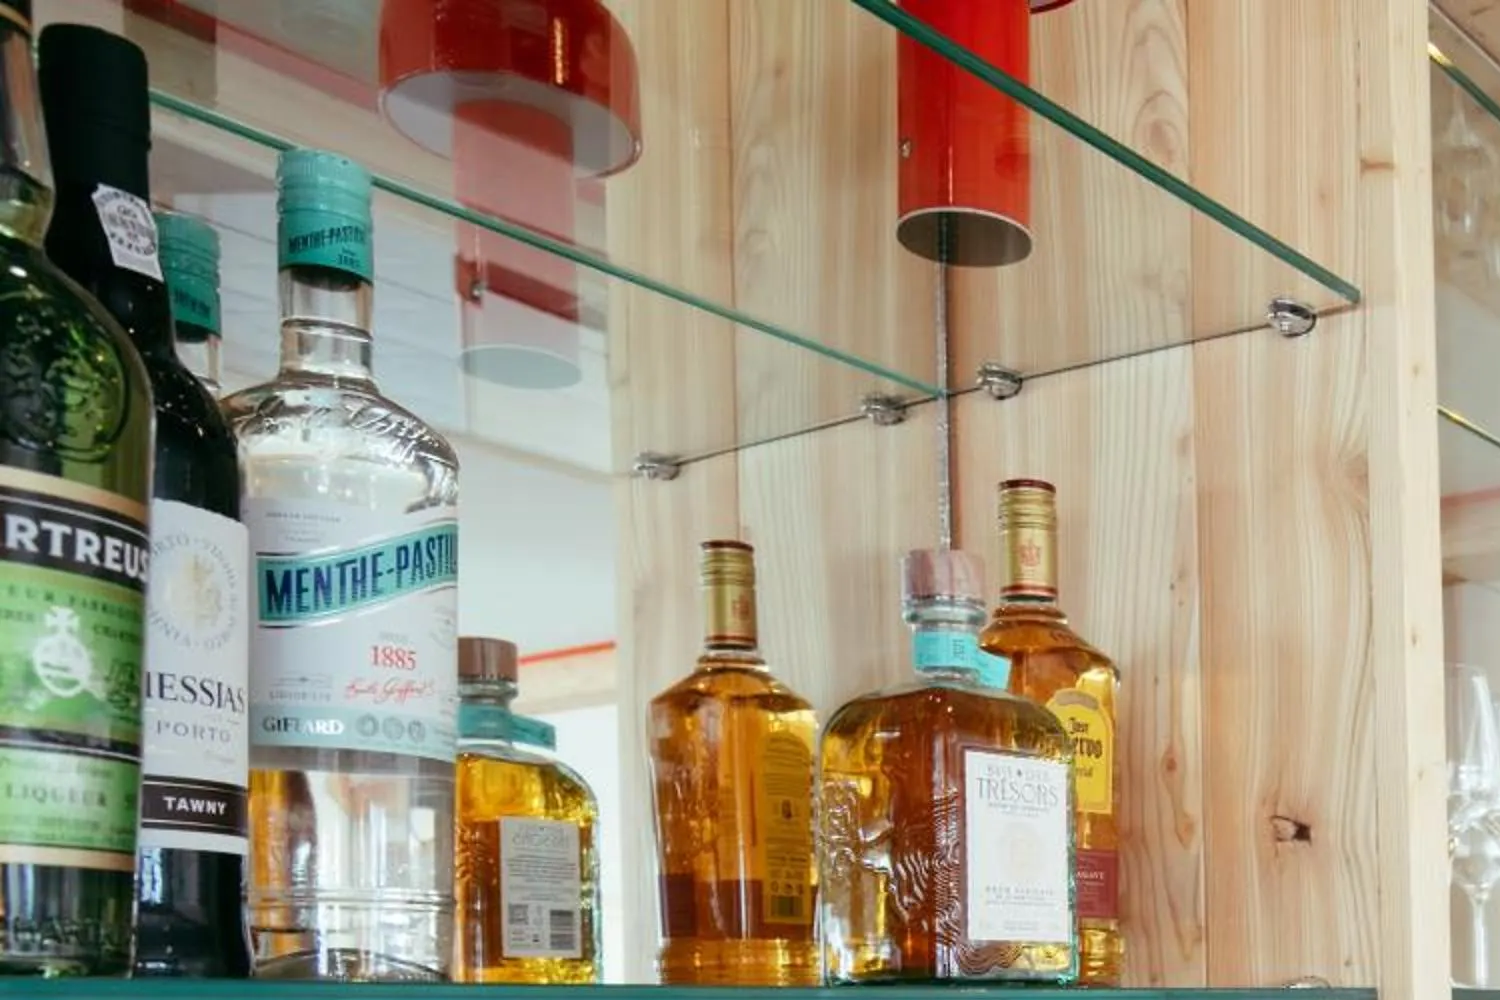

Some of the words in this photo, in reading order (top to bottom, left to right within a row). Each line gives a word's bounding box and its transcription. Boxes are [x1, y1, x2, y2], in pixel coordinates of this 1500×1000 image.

[370, 645, 417, 671] 1885
[156, 719, 232, 744] PORTO
[162, 795, 227, 816] TAWNY
